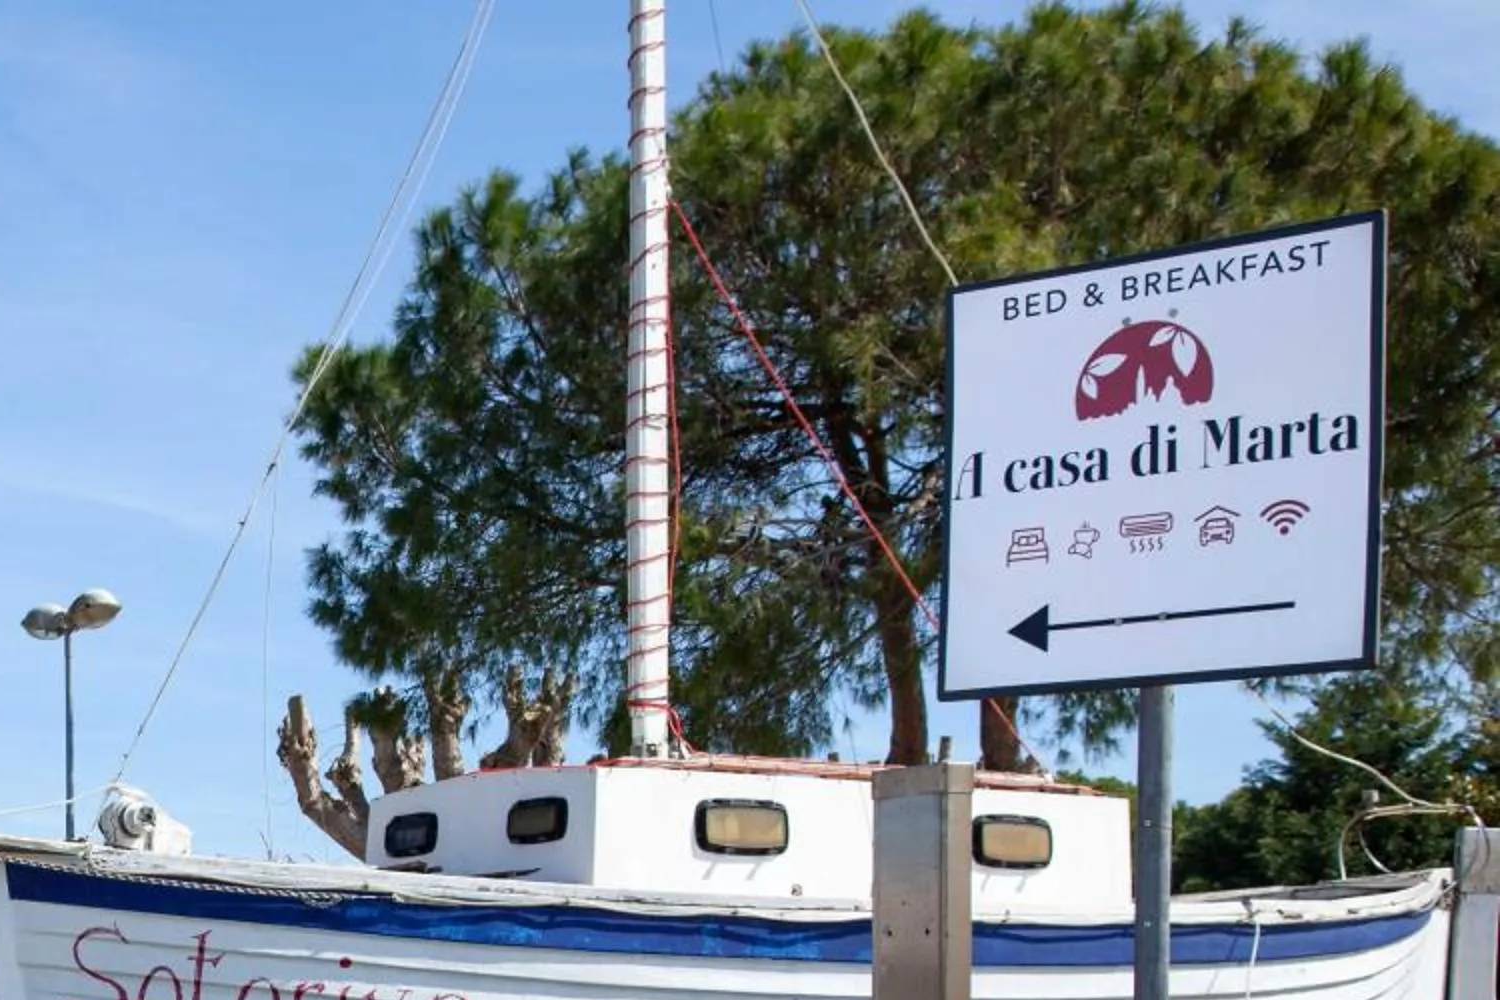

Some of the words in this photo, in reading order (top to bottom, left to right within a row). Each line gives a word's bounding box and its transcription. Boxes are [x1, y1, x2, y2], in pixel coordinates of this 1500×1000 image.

[1003, 290, 1067, 321] BED
[1083, 282, 1105, 308] &
[1121, 240, 1331, 301] BREAKFAST
[954, 451, 984, 501] A
[1003, 447, 1109, 494] casa
[1130, 423, 1178, 477] di
[1203, 411, 1359, 469] Marta
